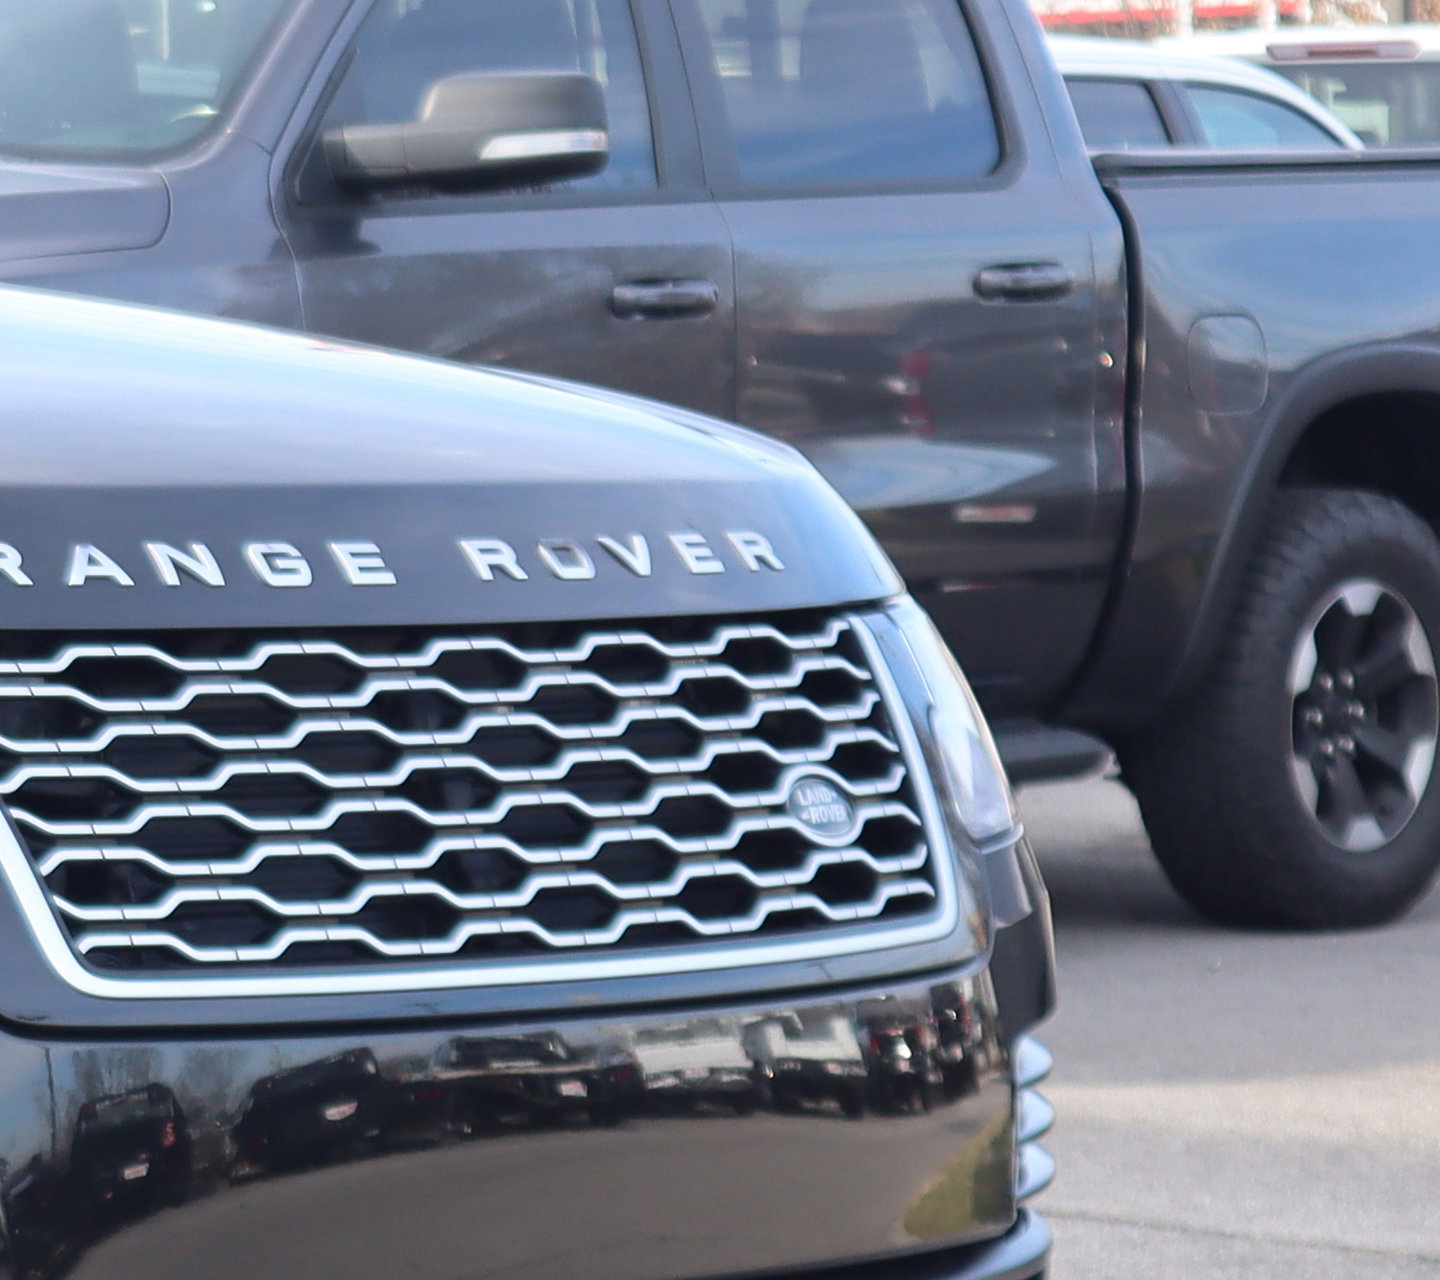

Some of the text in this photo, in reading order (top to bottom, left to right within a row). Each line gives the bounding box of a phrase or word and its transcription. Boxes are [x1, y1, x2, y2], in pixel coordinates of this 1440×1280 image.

[458, 530, 786, 581] ROVER
[797, 785, 833, 806] LAND
[809, 803, 849, 825] ROVER
